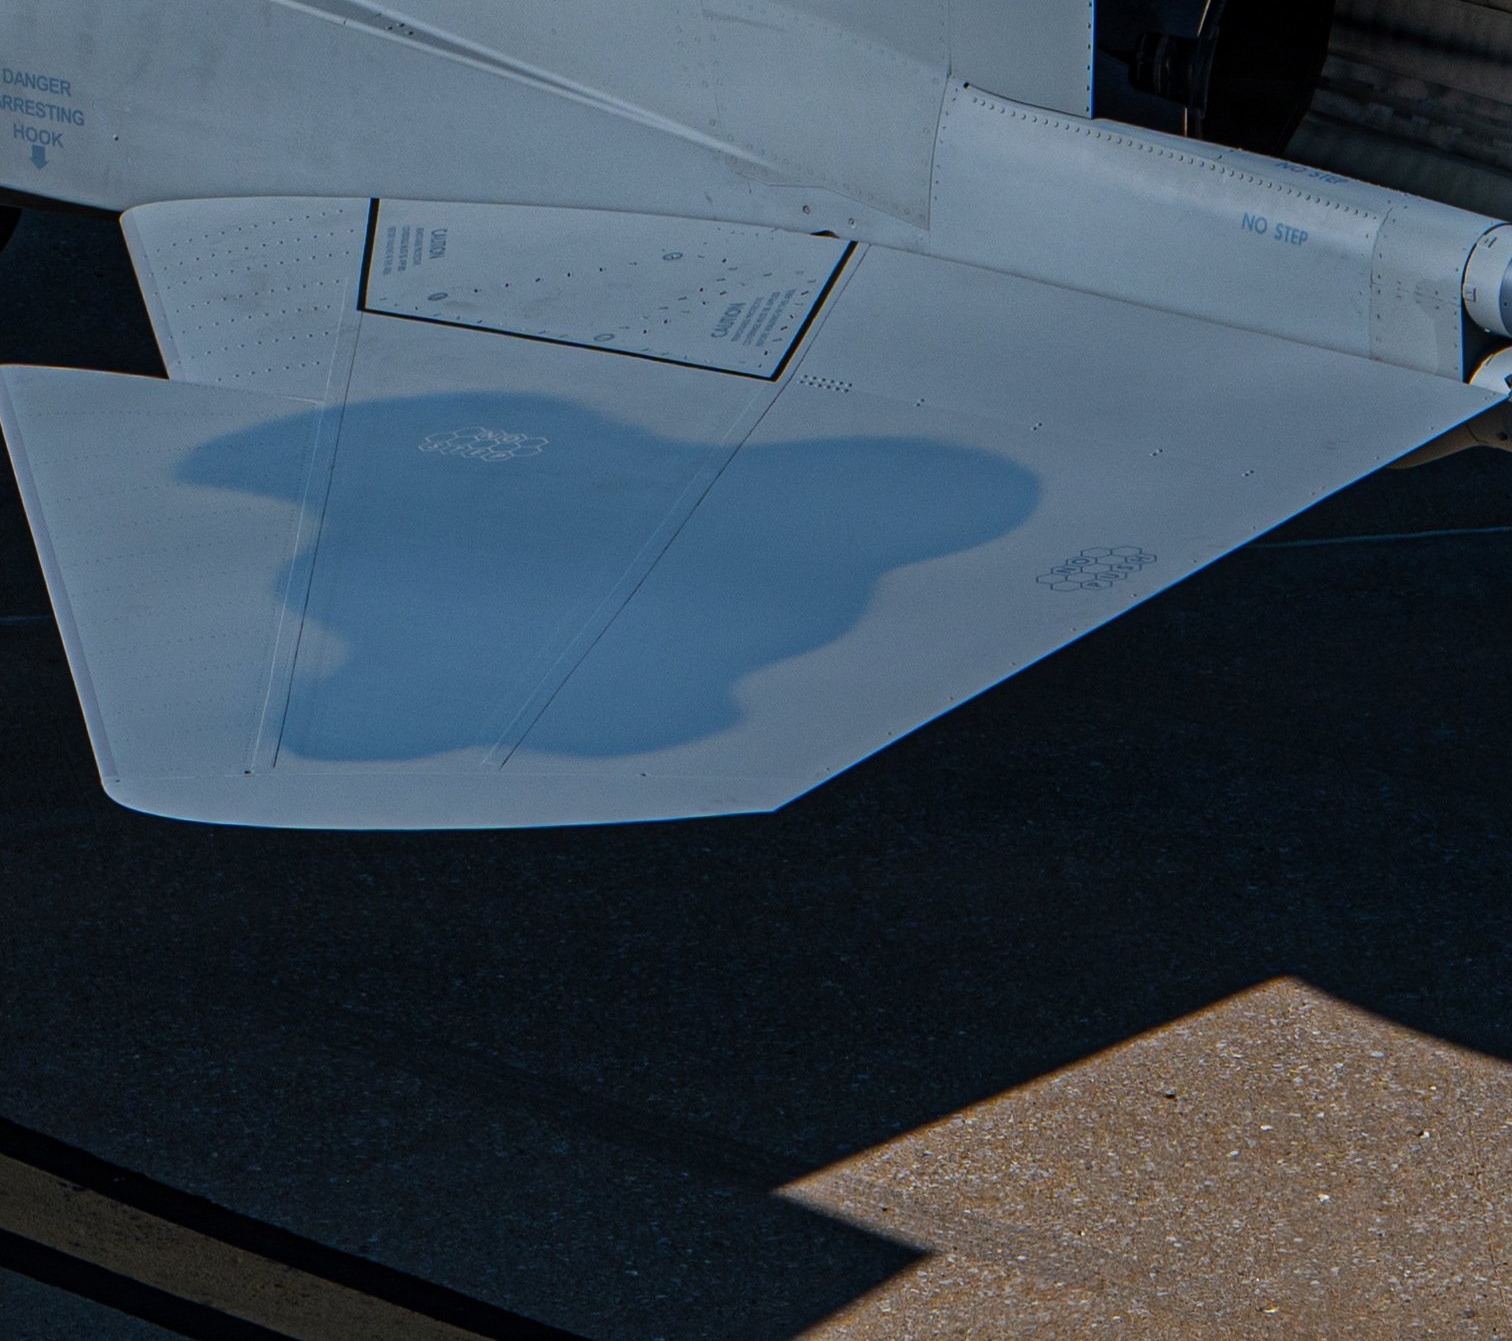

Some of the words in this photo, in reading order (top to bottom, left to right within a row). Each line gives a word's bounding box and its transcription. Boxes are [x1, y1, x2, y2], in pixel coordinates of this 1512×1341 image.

[2, 68, 72, 97] DANGER
[13, 123, 65, 149] HOOK
[1241, 211, 1268, 234] NO
[1274, 222, 1309, 246] STEP
